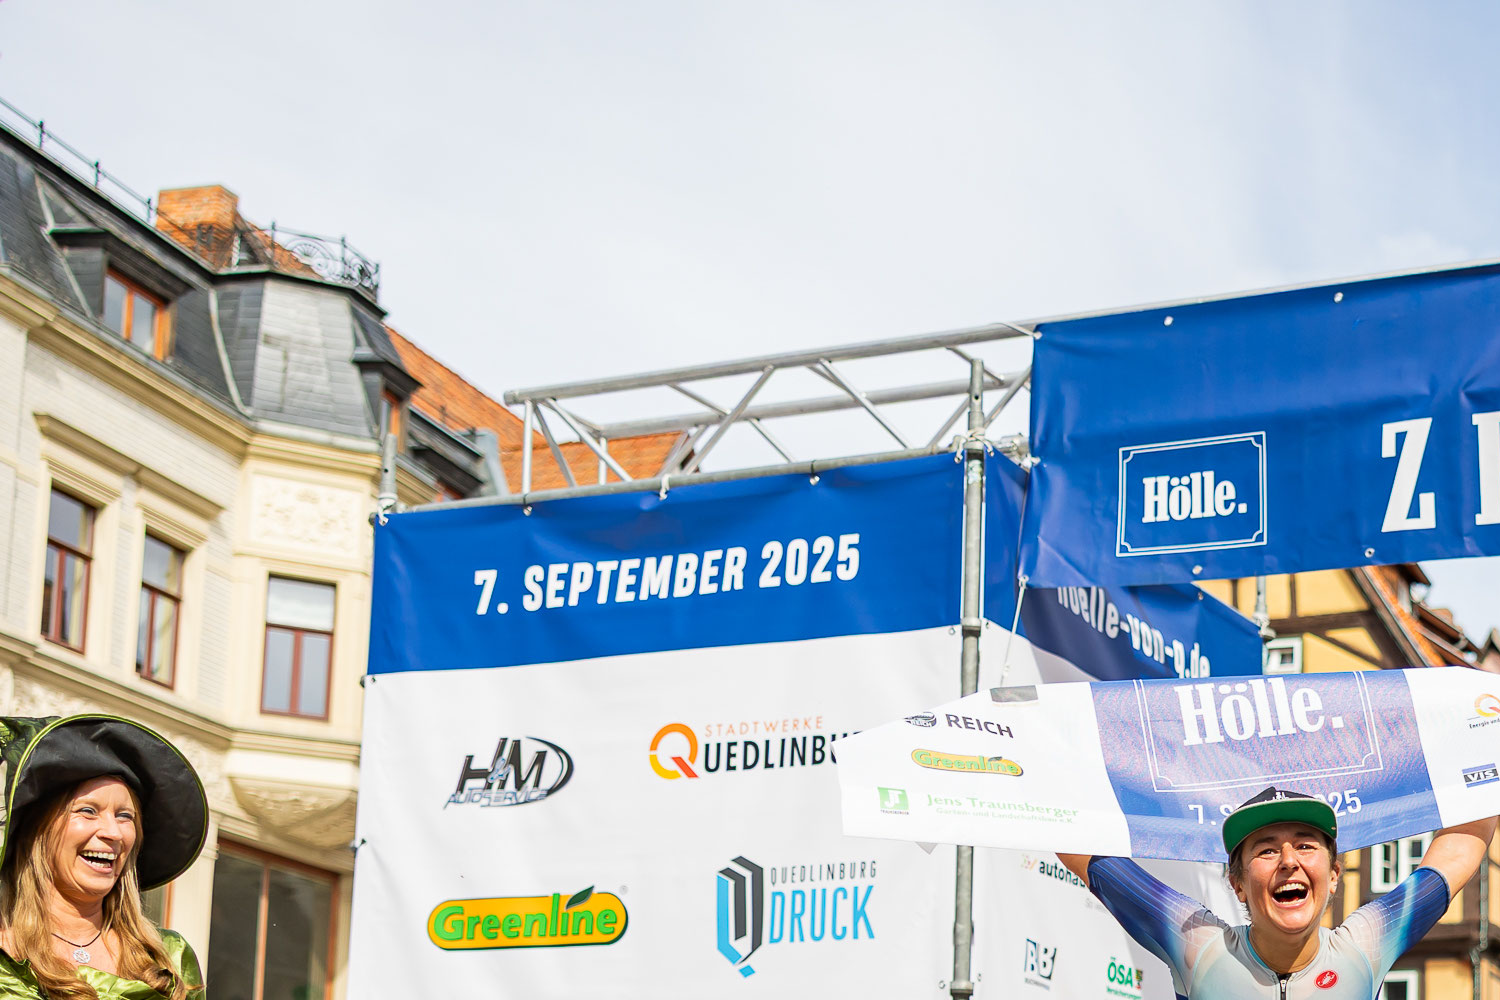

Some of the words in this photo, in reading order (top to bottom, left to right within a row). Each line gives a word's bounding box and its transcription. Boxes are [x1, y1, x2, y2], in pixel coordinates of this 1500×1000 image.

[1142, 471, 1247, 524] Hölle.
[474, 569, 509, 616] 7.
[522, 546, 747, 613] SEPTEMBER
[758, 532, 861, 589] 2025
[944, 713, 1014, 739] REICH
[1174, 677, 1345, 746] Hölle.
[704, 716, 824, 738] STADTWERKE
[649, 722, 862, 780] QUEDLINB
[914, 751, 1019, 774] Greenline
[1465, 769, 1496, 783] VIS
[927, 794, 962, 808] Jens
[969, 797, 1079, 817] Traunsberger
[1187, 803, 1217, 826] 7.
[770, 860, 878, 887] QUEDLINBURG
[433, 892, 619, 943] Greenline
[769, 884, 877, 944] DRUCK
[1107, 956, 1134, 989] ÖSA
